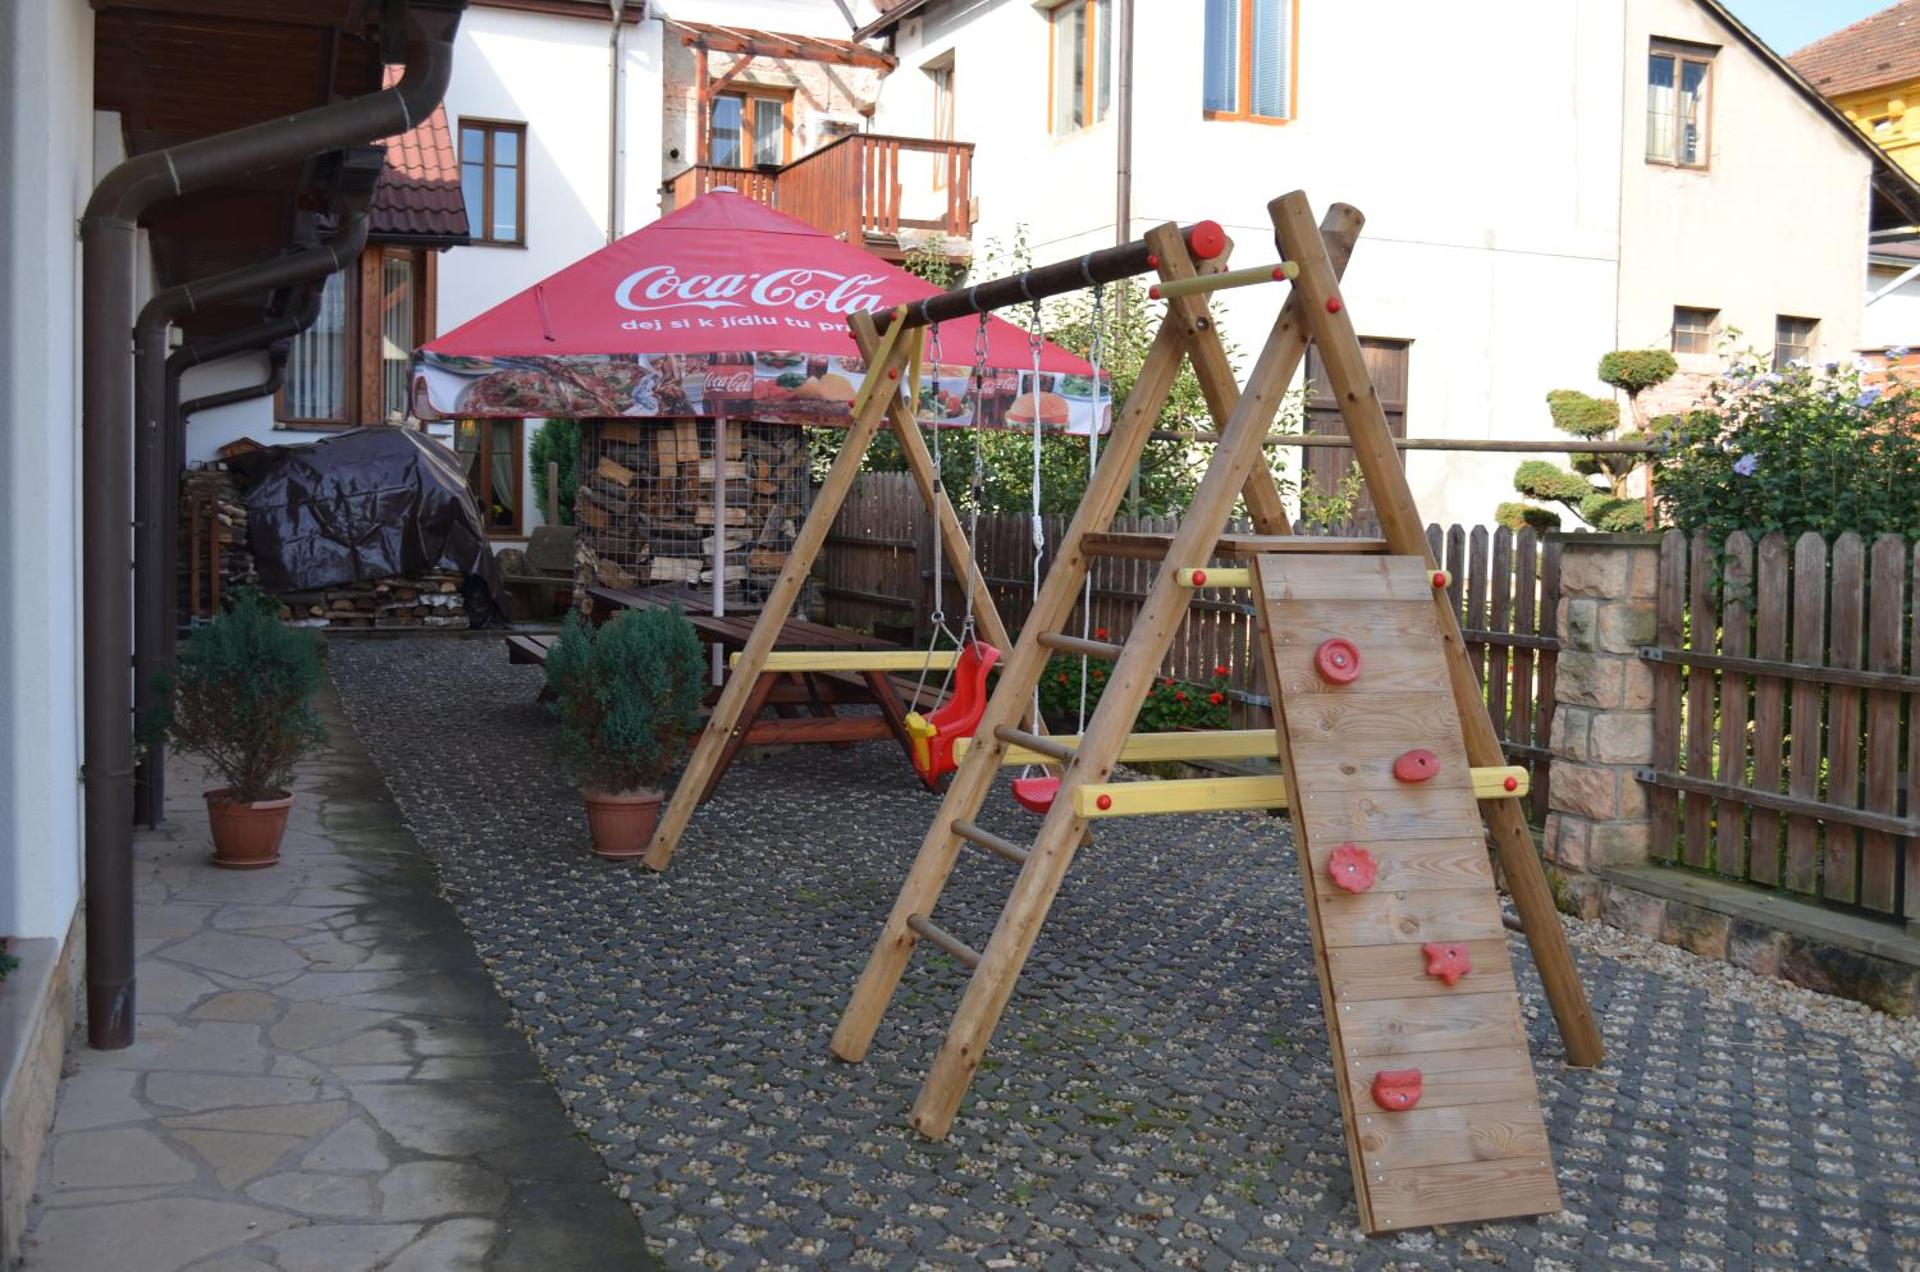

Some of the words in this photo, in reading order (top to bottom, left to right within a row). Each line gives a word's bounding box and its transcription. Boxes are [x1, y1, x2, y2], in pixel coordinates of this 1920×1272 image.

[614, 265, 888, 314] Coca-Cola
[621, 319, 662, 331] dej
[671, 318, 690, 329] si
[698, 318, 714, 327] k
[784, 316, 811, 328] tu
